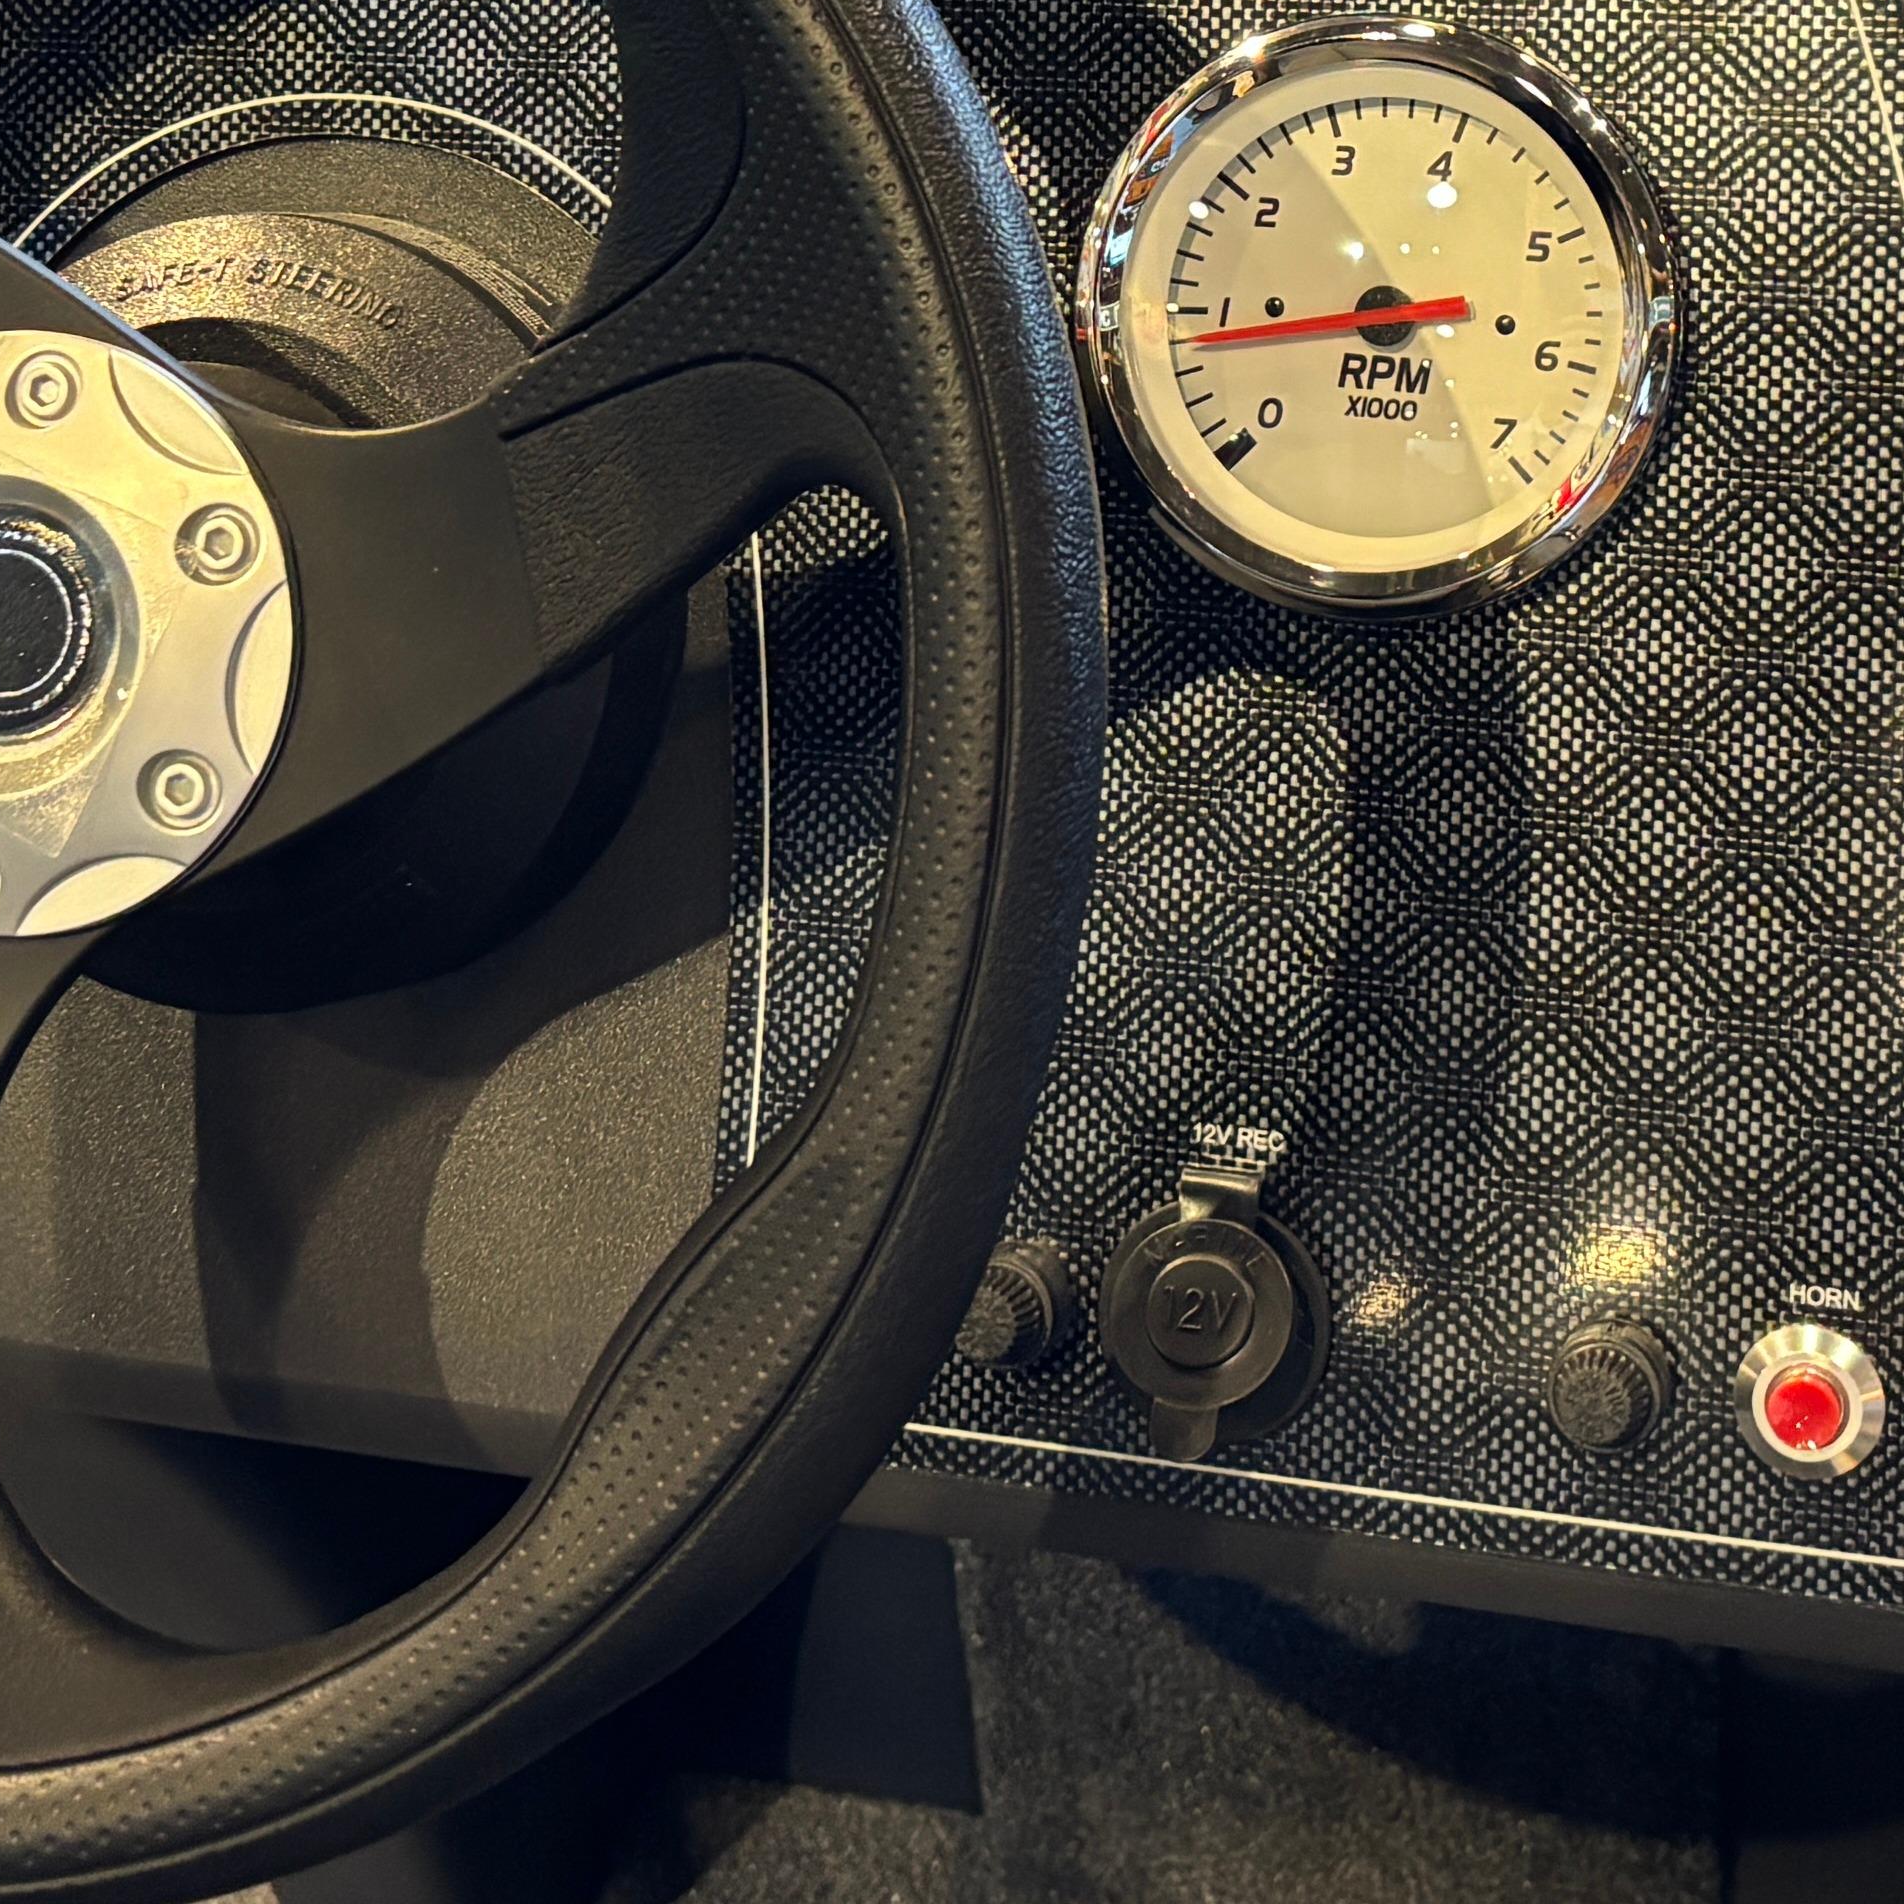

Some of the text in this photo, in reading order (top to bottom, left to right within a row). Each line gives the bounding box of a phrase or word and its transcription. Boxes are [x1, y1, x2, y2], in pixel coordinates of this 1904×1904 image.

[1331, 146, 1355, 177] 3
[1427, 150, 1454, 182] 4
[1254, 196, 1280, 228] 2
[1525, 232, 1551, 263] 5
[246, 257, 404, 329] STEERING
[1534, 341, 1560, 372] 6
[1337, 352, 1433, 395] RPM
[1257, 397, 1284, 429] 0
[1344, 395, 1418, 422] X1000
[1489, 419, 1518, 451] 7
[1191, 1122, 1285, 1152] 12V REC
[1163, 1286, 1238, 1331] 12V
[1789, 1281, 1861, 1311] HORN
